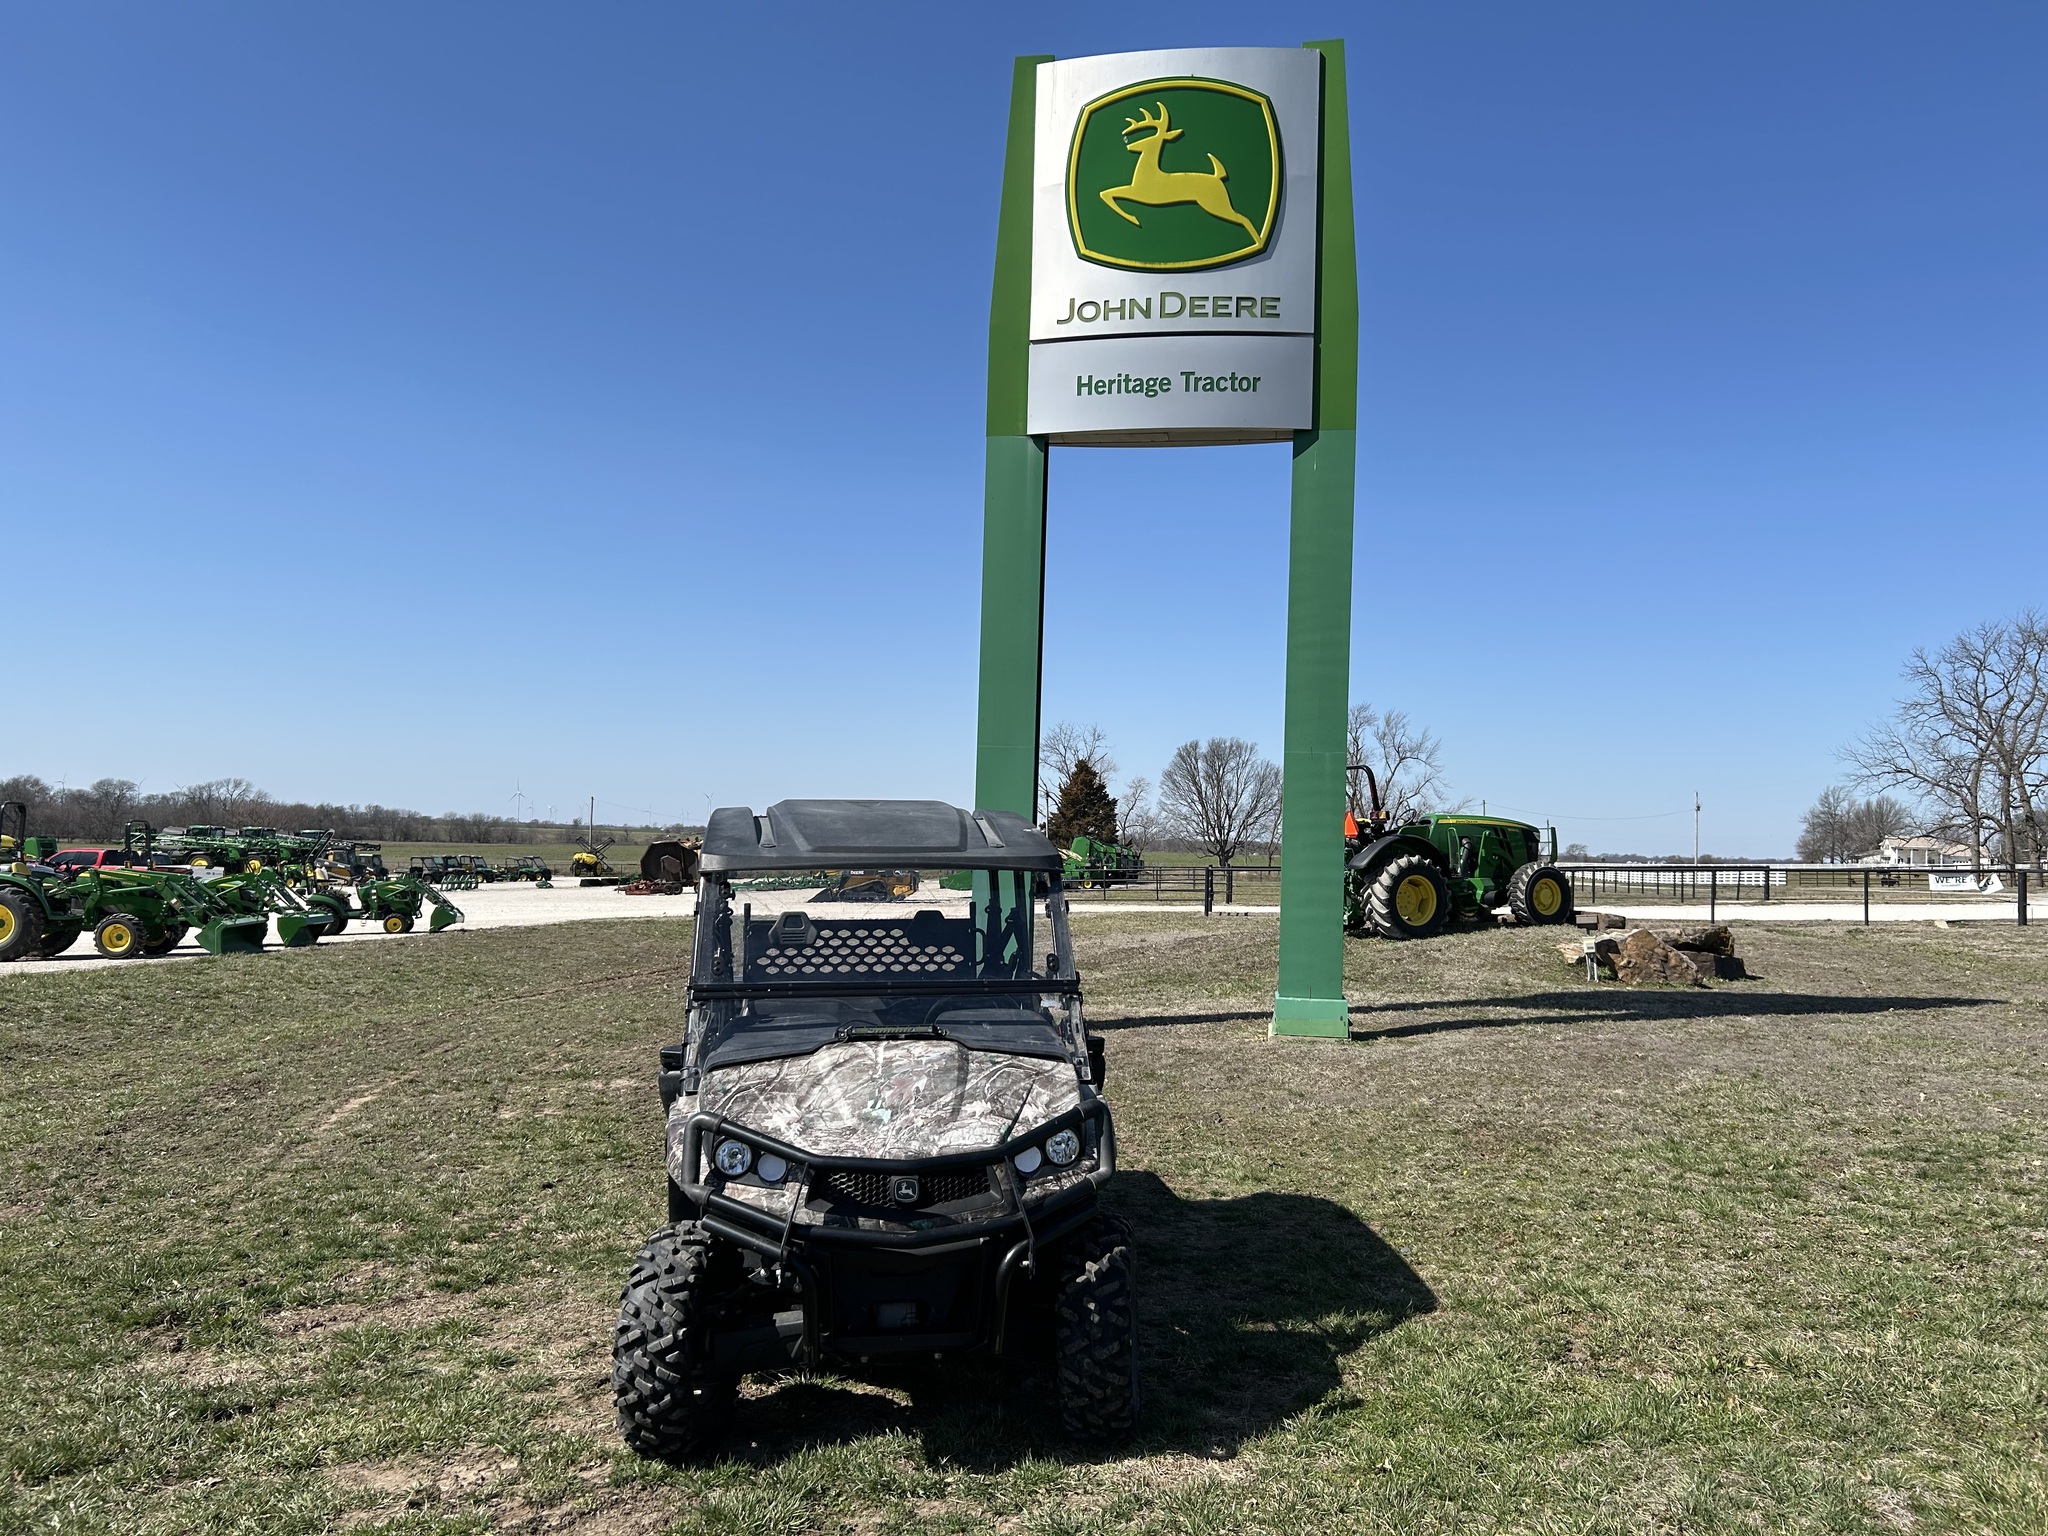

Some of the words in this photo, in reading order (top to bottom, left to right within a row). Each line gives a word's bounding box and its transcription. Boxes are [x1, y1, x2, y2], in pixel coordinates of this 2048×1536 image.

[1057, 297, 1152, 325] JOHN
[1160, 291, 1281, 319] DEERE
[1076, 373, 1172, 398] Heritage
[1180, 371, 1262, 393] Tractor
